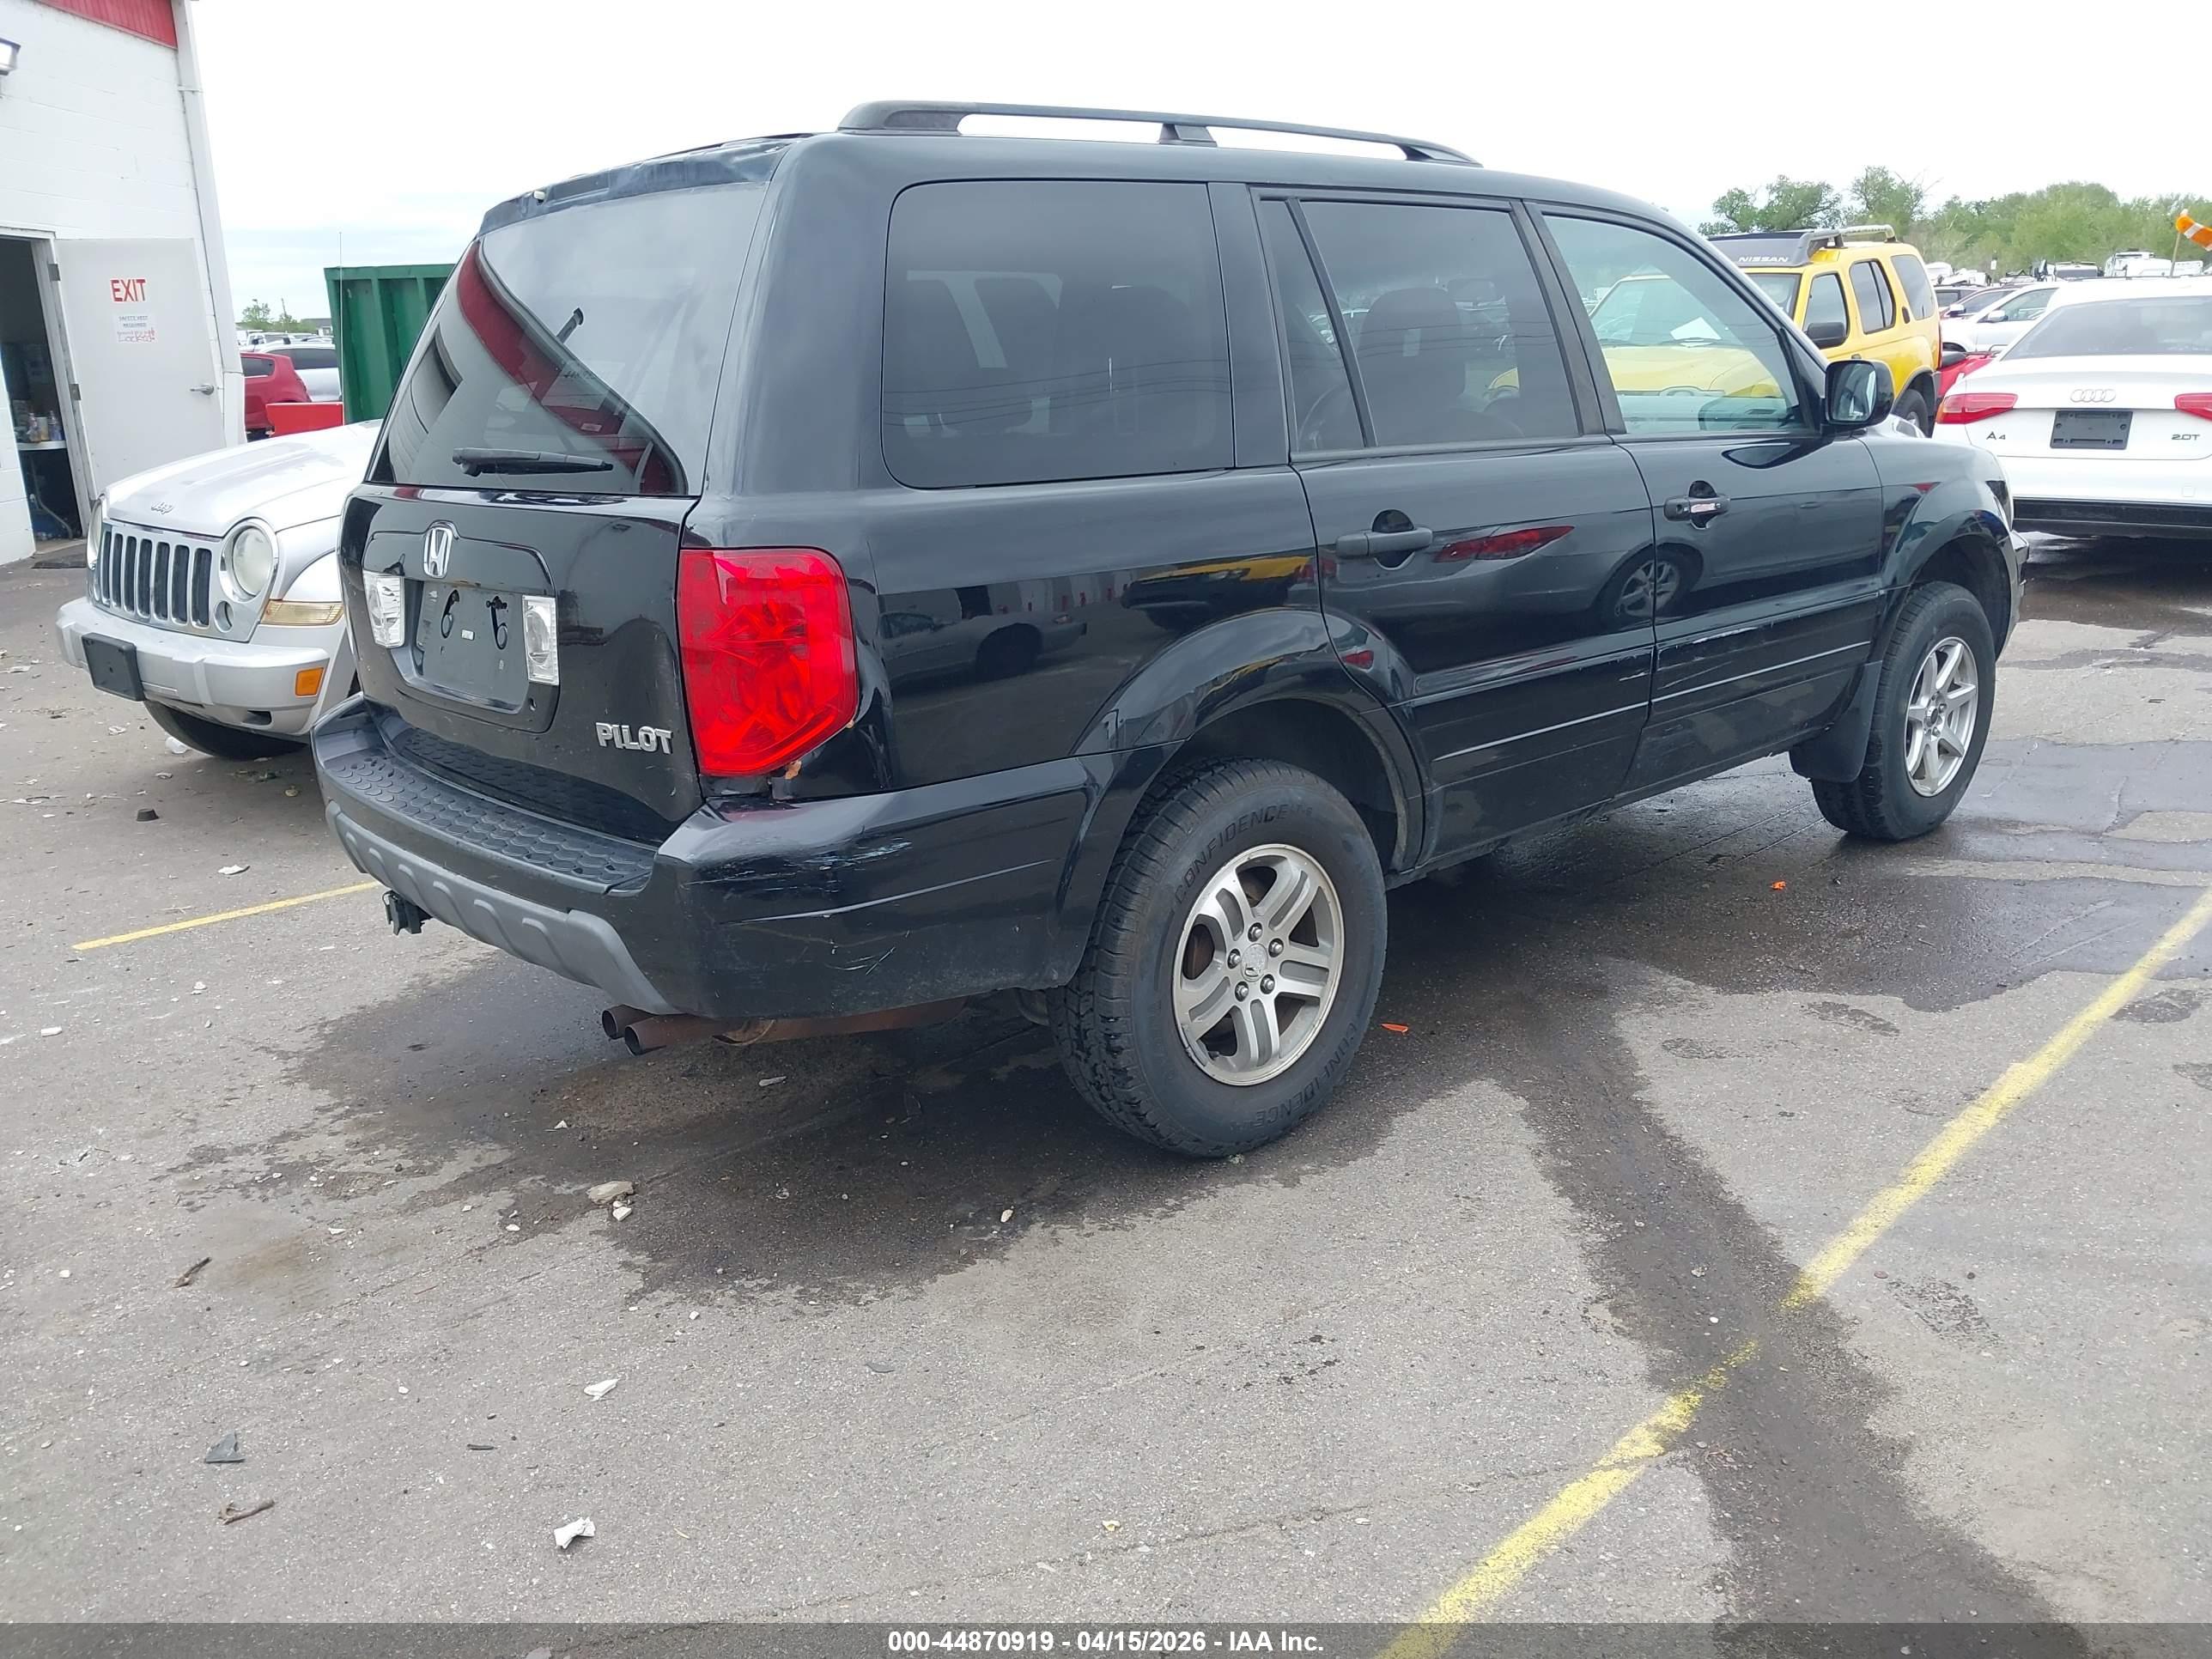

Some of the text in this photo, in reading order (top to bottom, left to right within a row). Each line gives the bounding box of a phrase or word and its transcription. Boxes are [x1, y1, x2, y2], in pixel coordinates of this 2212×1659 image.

[110, 278, 146, 302] EXIT
[1985, 431, 2006, 441] A4
[595, 722, 673, 755] PILOT
[1175, 804, 1289, 904] CONFIDENCE
